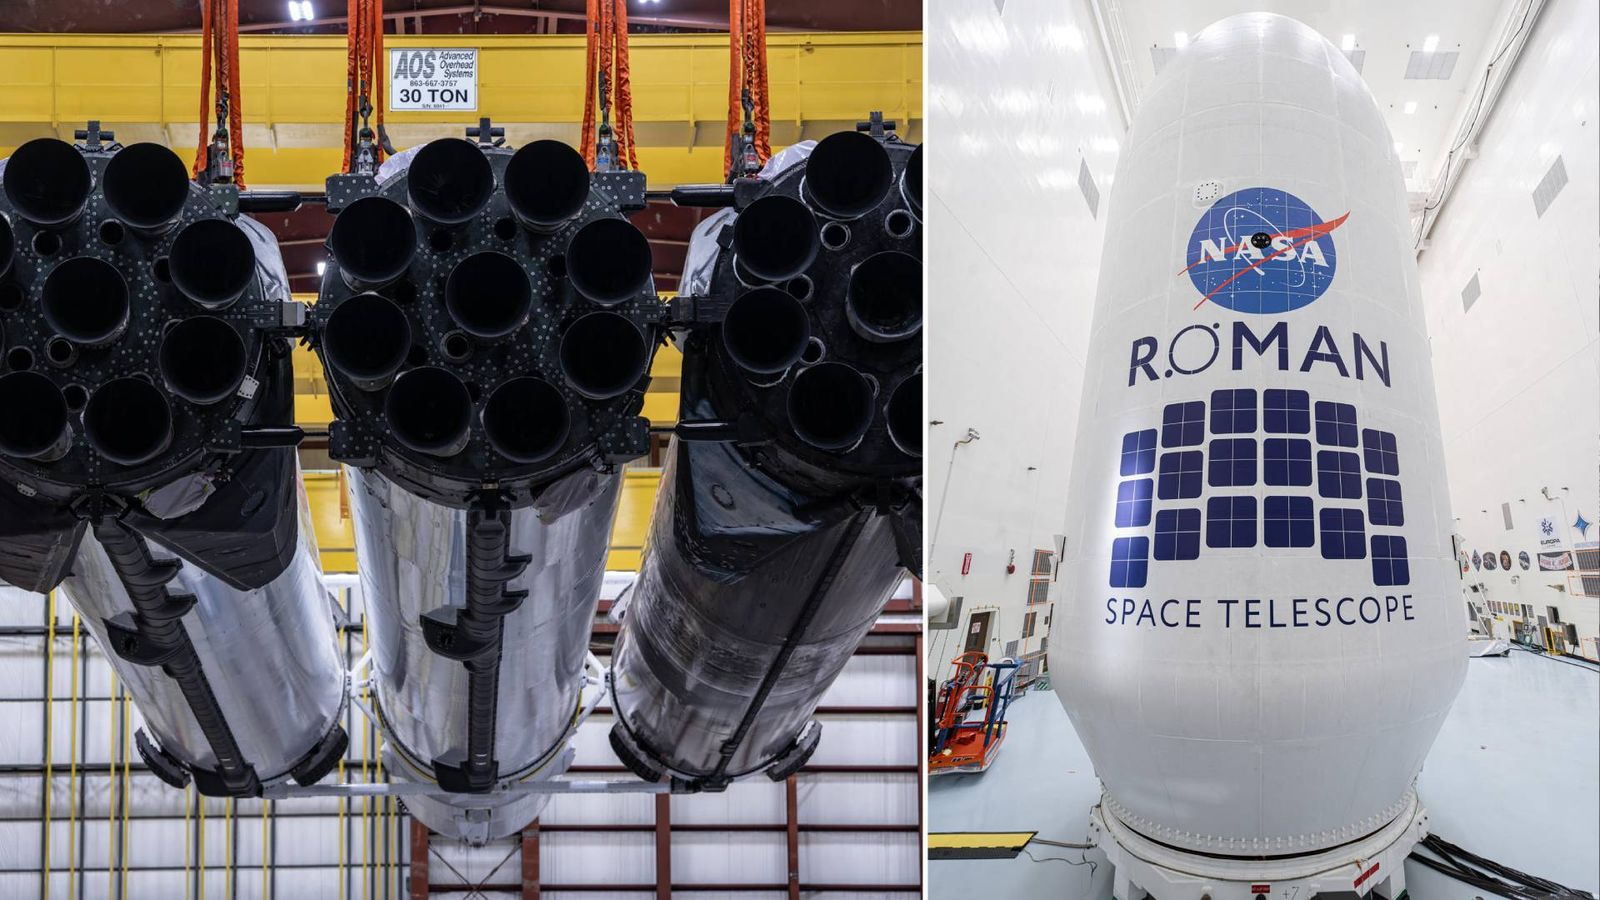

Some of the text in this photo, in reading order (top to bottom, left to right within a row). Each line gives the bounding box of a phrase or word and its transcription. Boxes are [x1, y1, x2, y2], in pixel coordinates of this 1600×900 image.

[394, 51, 436, 79] AOS
[439, 51, 474, 60] Advanced
[440, 60, 474, 69] Overhead
[444, 69, 473, 79] Systems
[400, 89, 468, 103] 30 TON
[1200, 235, 1329, 267] NASA
[1128, 321, 1391, 387] ROMAN
[1105, 597, 1201, 627] SPACE
[1217, 595, 1415, 628] TELESCOPE
